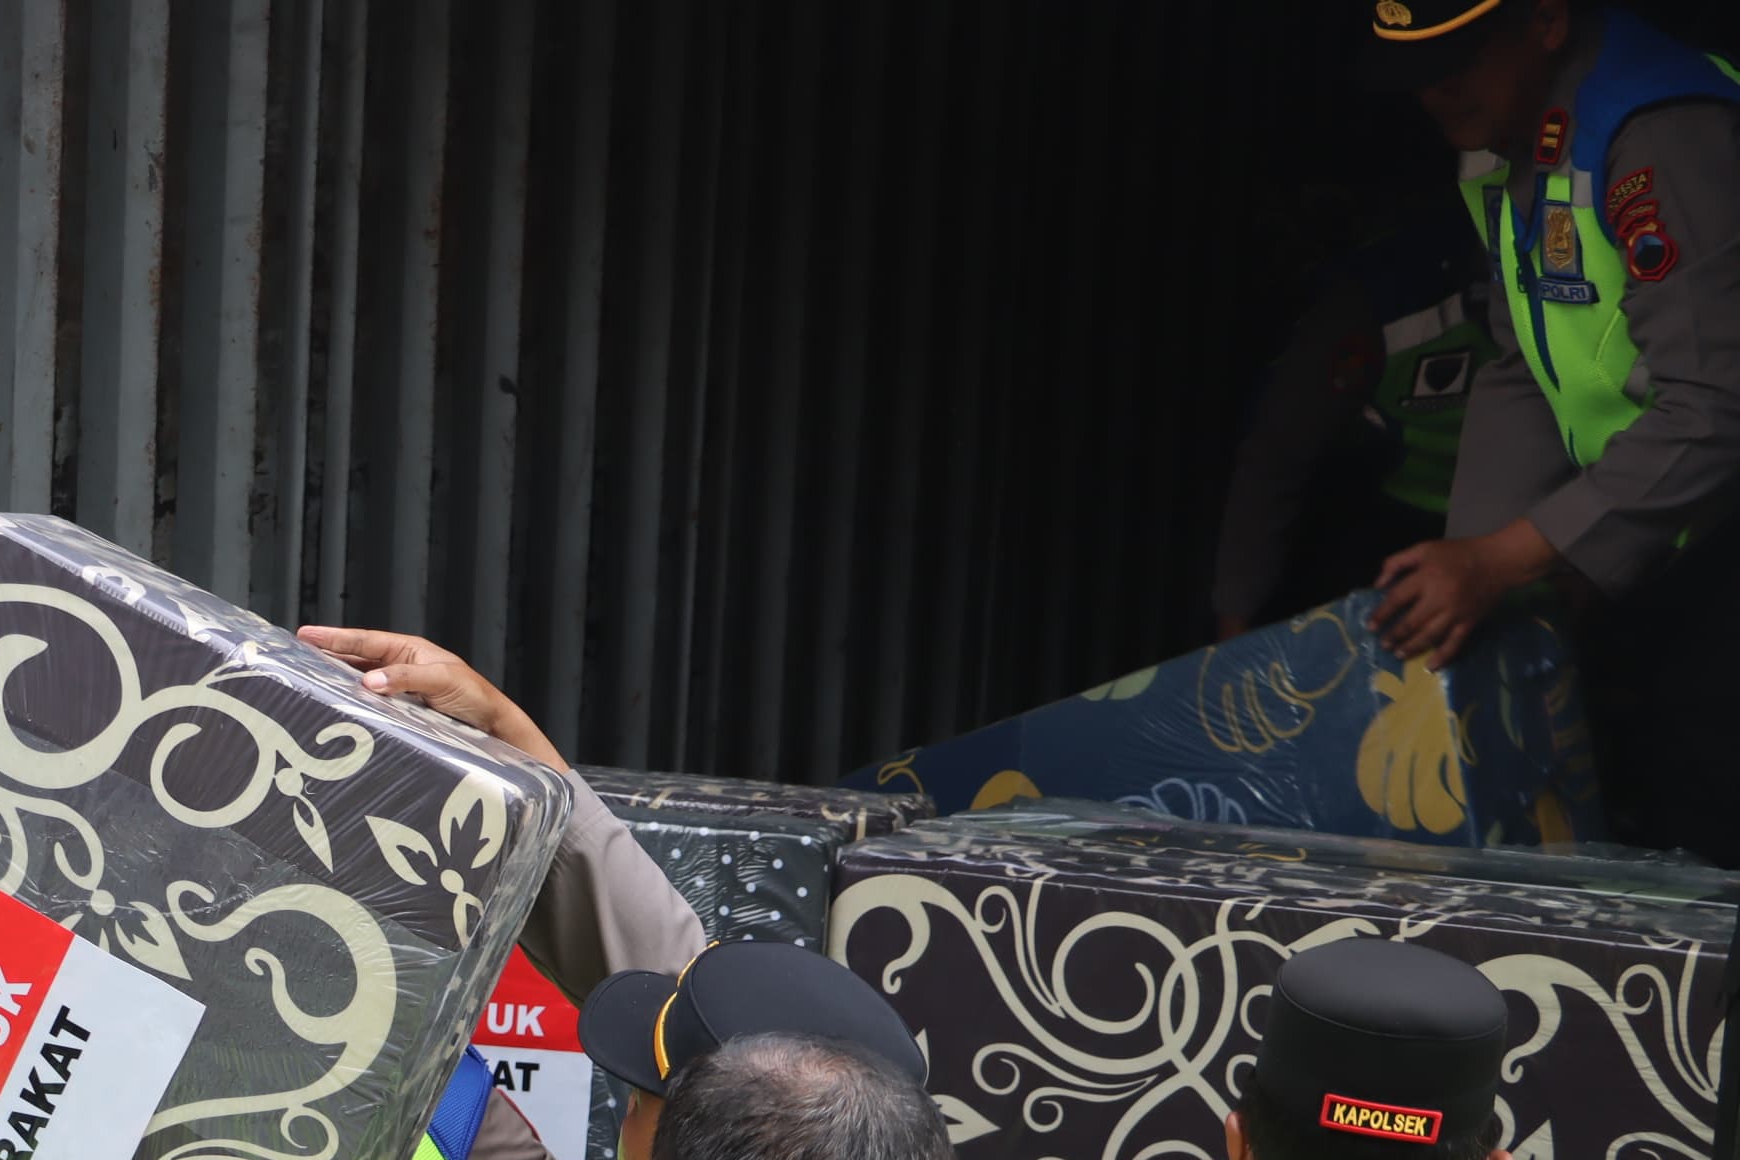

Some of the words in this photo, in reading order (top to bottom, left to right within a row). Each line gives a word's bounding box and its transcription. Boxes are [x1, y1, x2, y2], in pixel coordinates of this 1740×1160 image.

[1541, 284, 1588, 300] POLRI
[484, 1002, 546, 1037] UK
[484, 1059, 540, 1092] AT
[1333, 1102, 1427, 1137] KAPOLSEK
